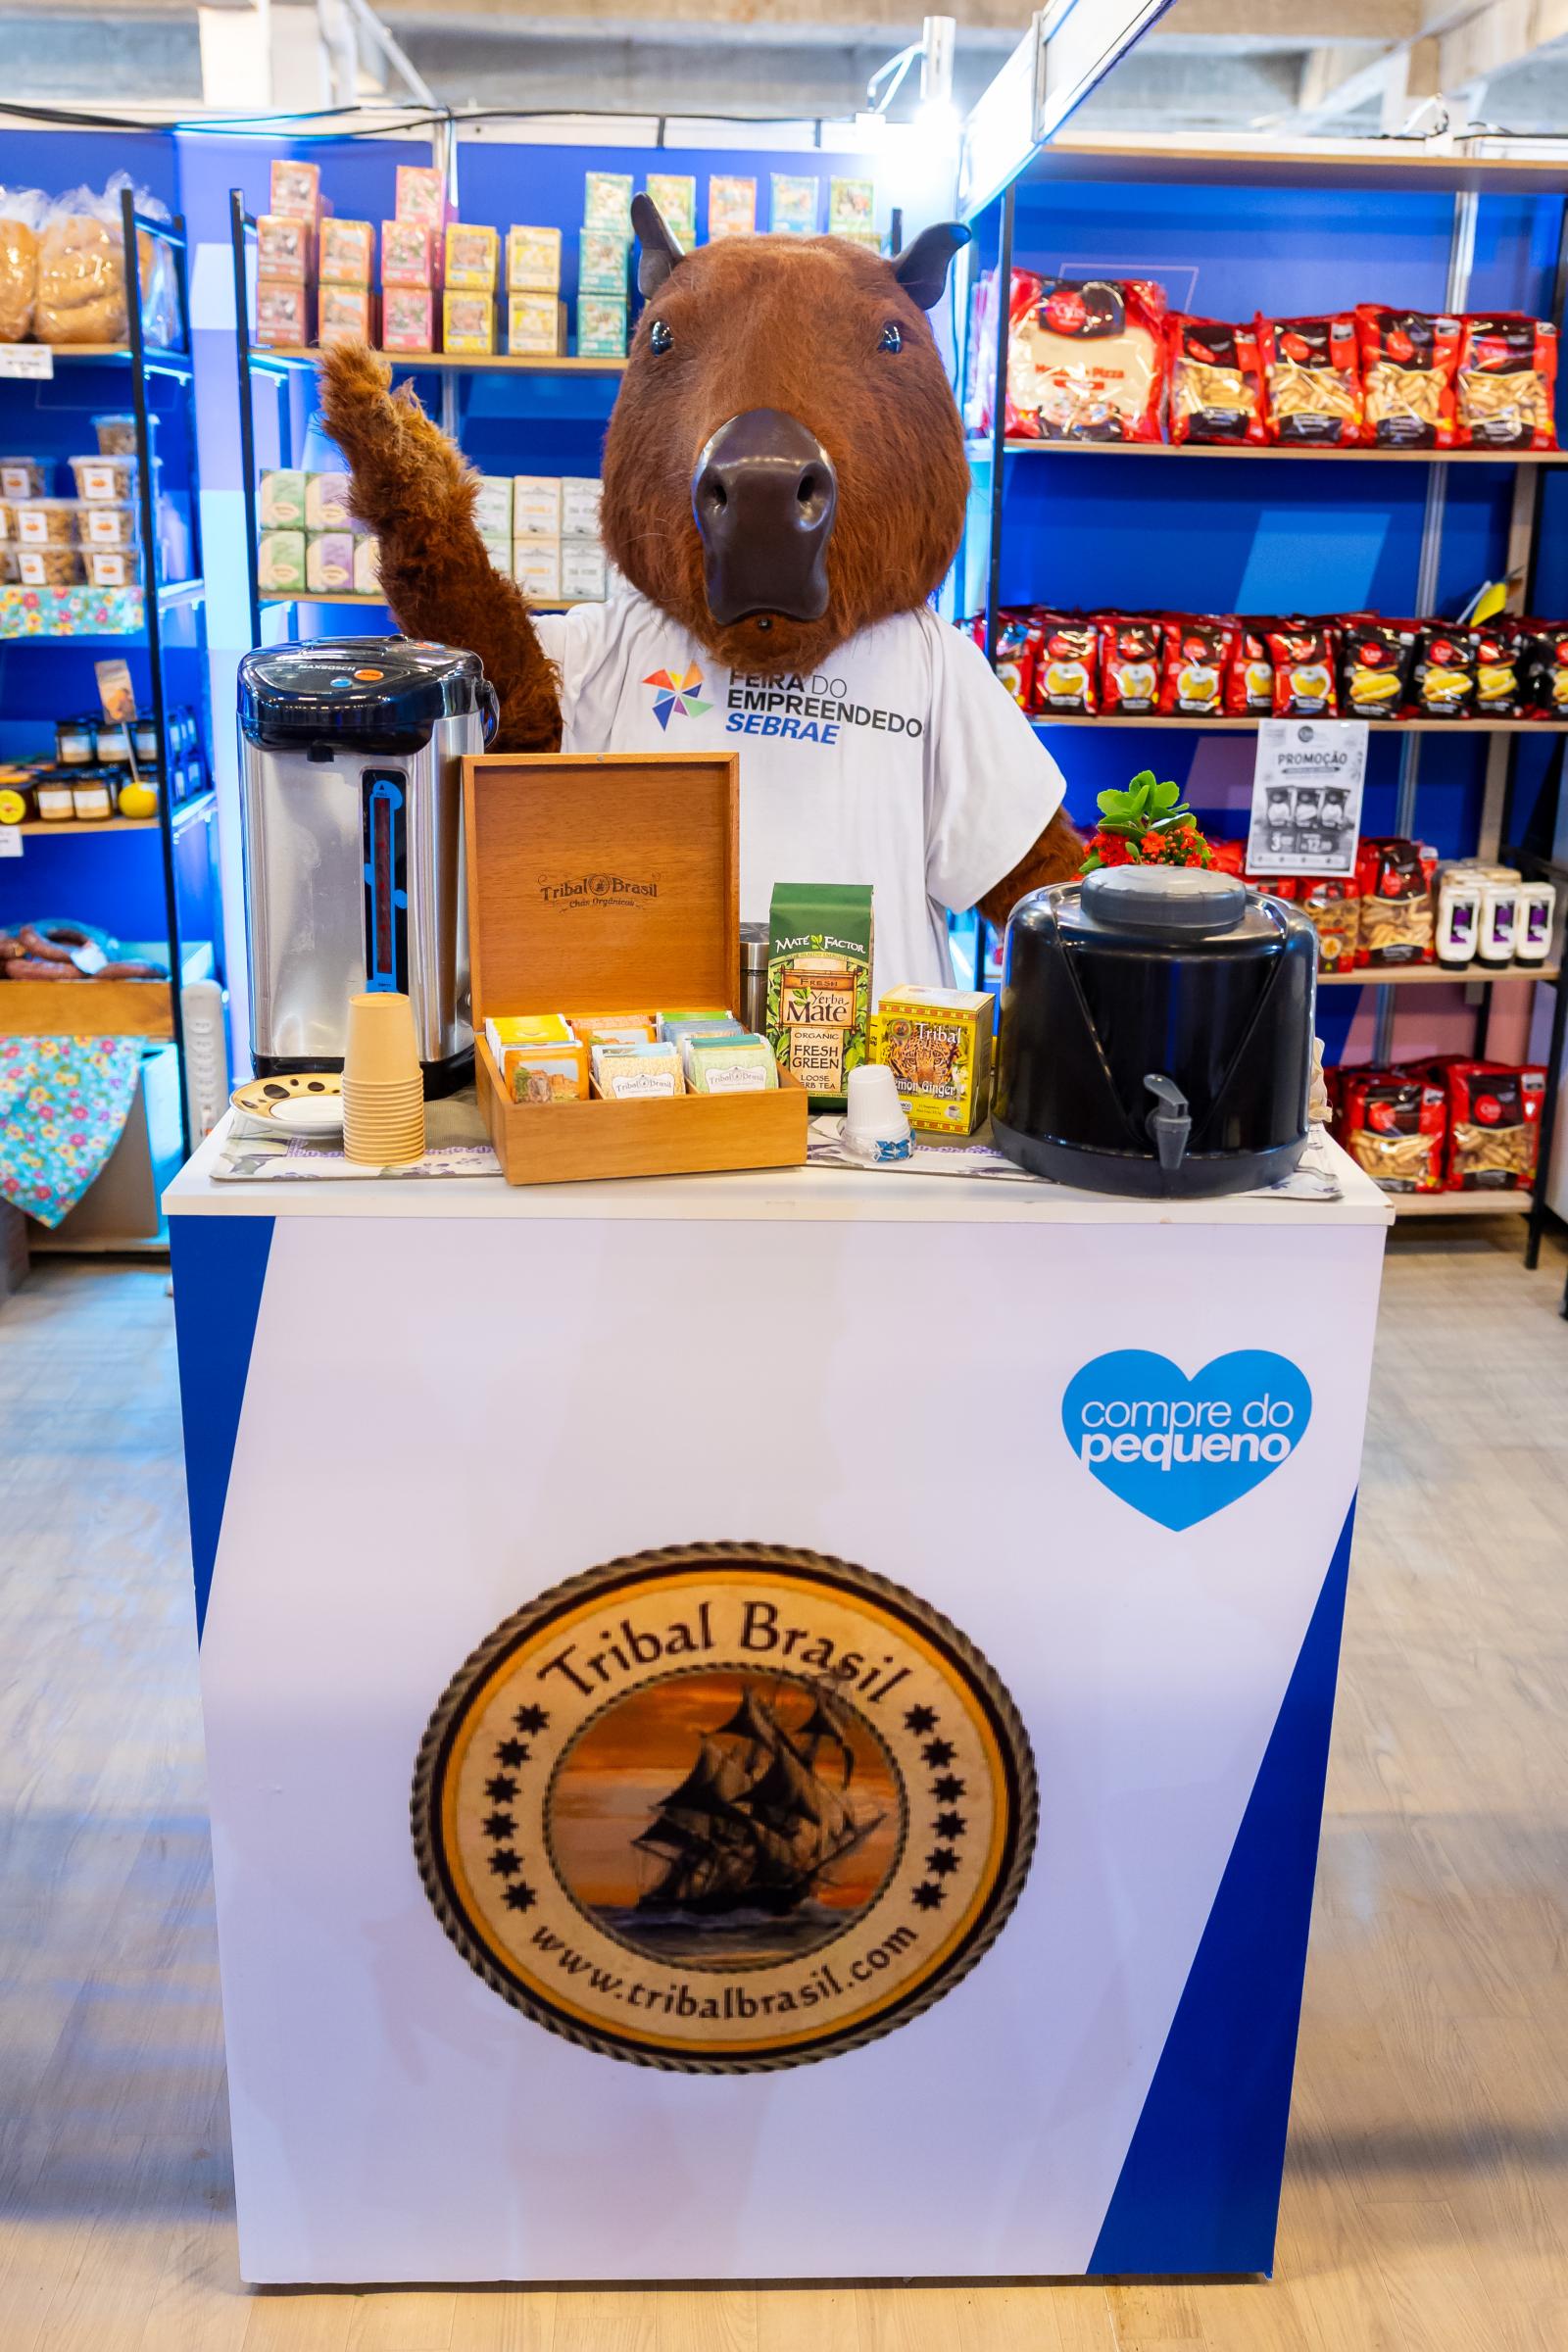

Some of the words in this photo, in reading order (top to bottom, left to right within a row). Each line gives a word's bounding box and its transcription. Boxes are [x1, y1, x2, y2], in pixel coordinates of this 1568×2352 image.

[811, 674, 848, 699] DO
[727, 689, 923, 738] EMPREENDEDO
[725, 712, 840, 745] SEBRAE
[1278, 750, 1348, 767] PROMOÇÃO
[540, 877, 587, 901] Tribal
[612, 877, 658, 897] Brasil
[824, 936, 866, 954] FACTOR
[800, 977, 838, 986] FRESH
[811, 991, 844, 1005] Yerba
[787, 1001, 850, 1023] Maté
[915, 1022, 961, 1045] Tribal
[792, 1056, 840, 1069] GREEN
[794, 1045, 839, 1057] FRESH
[921, 1080, 956, 1097] Ginger
[1081, 1400, 1232, 1435] compre
[1243, 1393, 1295, 1428] do
[1080, 1433, 1292, 1471] pequeno
[536, 1600, 715, 1696] Tribal
[738, 1600, 913, 1703] Brasil
[529, 1924, 919, 2020] www.tribalbrasil.com
